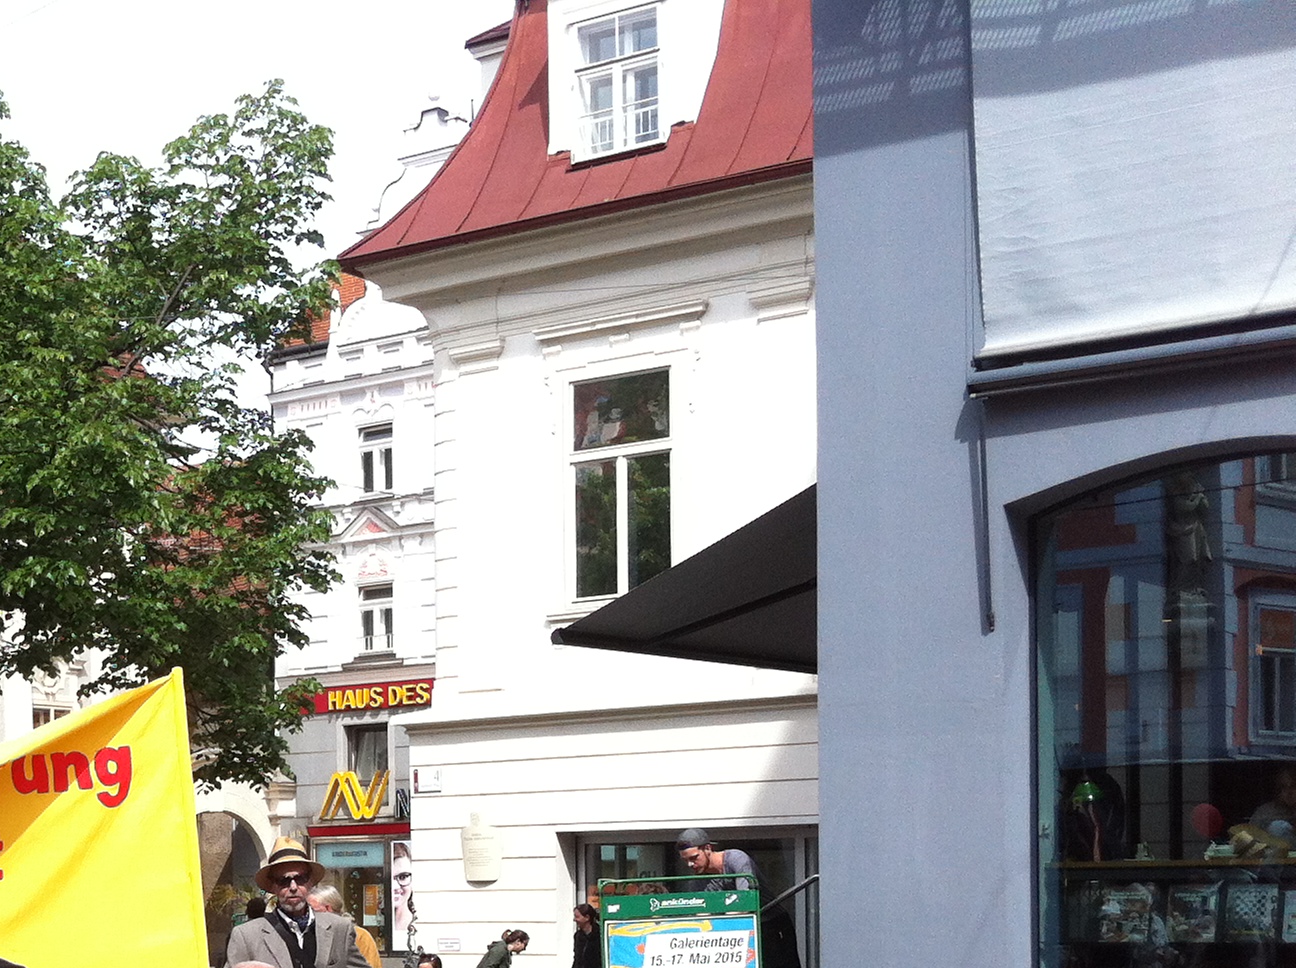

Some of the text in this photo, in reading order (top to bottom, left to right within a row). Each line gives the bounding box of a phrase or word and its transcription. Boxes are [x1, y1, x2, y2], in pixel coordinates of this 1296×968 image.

[328, 684, 431, 710] HAUS DES
[670, 936, 745, 950] Galerientage
[689, 953, 711, 965] Mai
[714, 951, 742, 964] 2015
